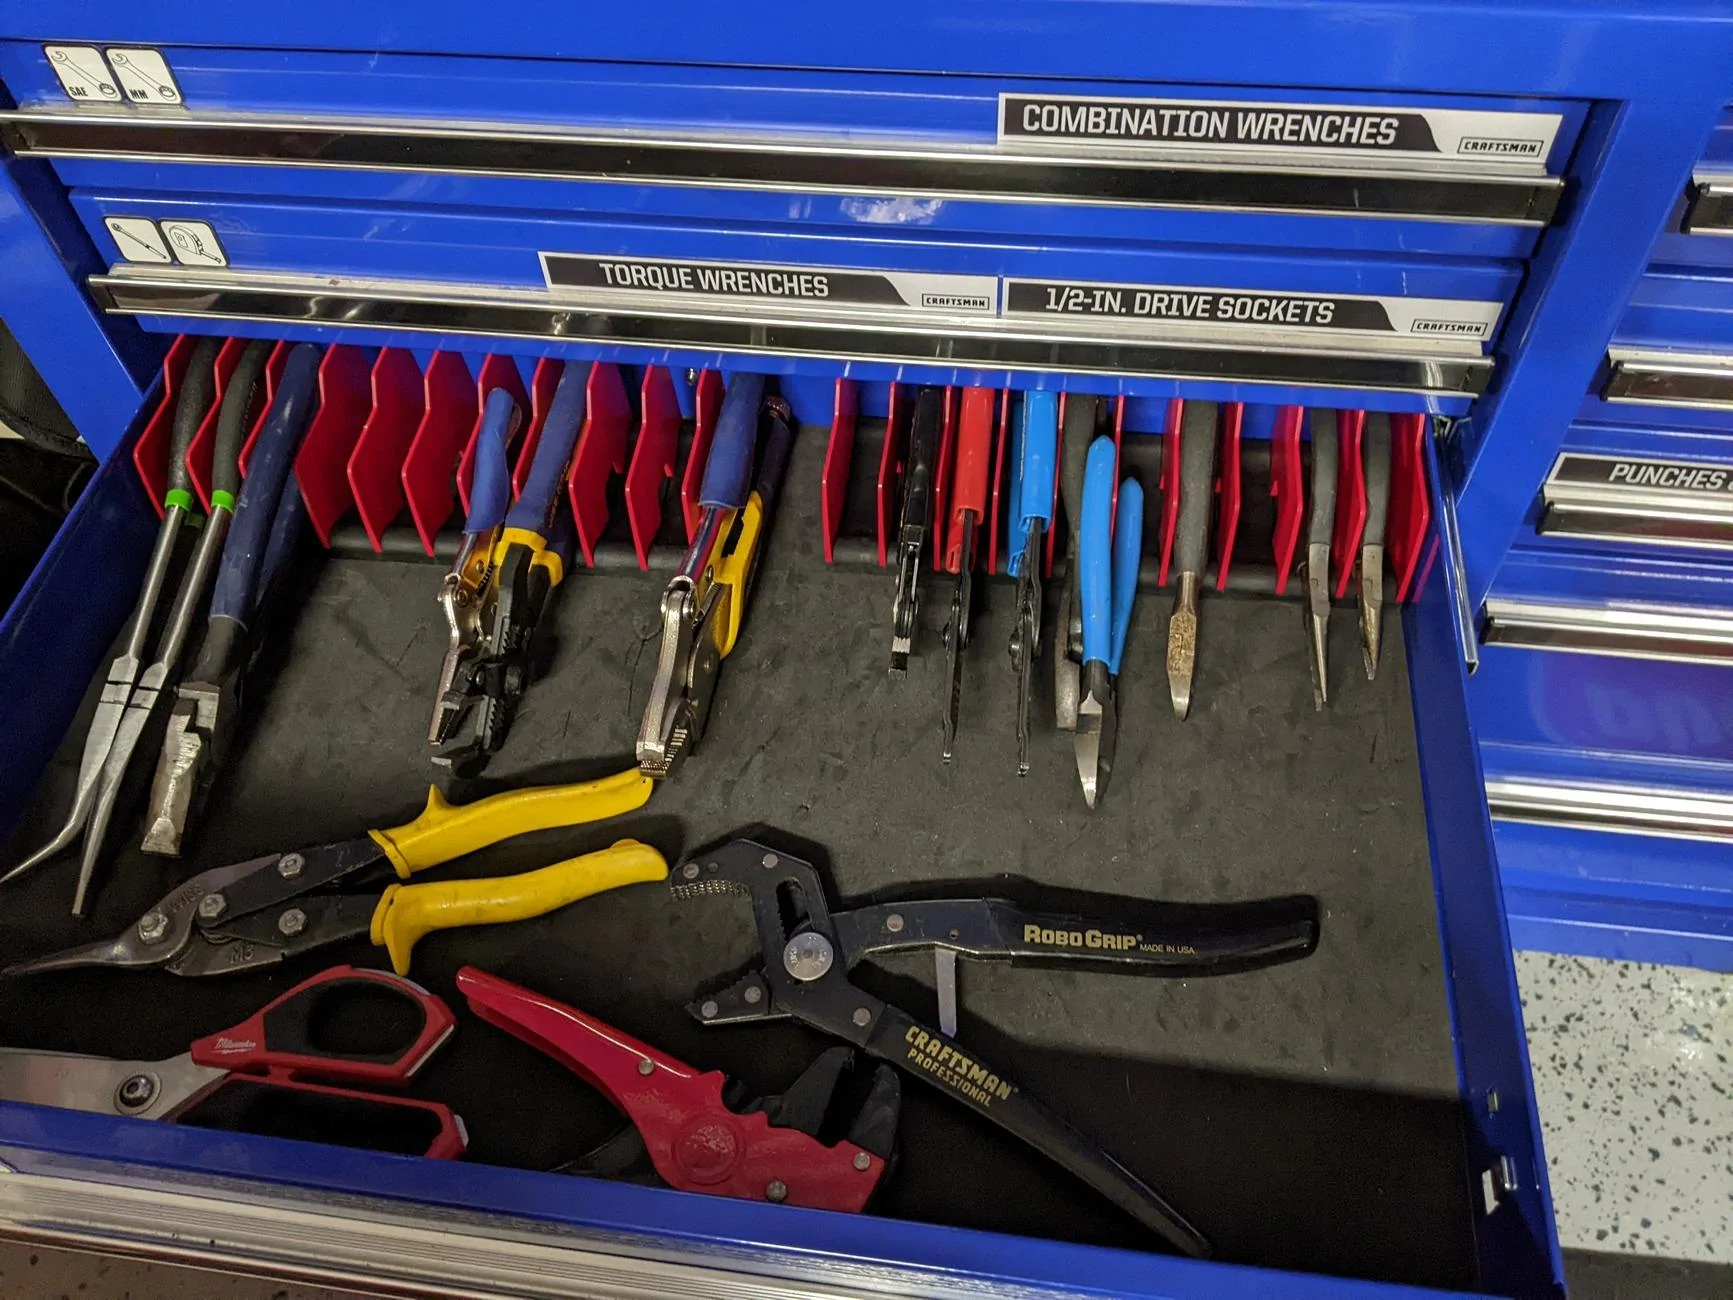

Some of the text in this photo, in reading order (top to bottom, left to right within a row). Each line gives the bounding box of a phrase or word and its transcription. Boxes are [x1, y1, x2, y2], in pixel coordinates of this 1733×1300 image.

[68, 86, 88, 97] SAE
[129, 89, 149, 99] MM
[1022, 104, 1399, 145] COMBINATION WRENCHES
[1463, 140, 1538, 153] CRAFTSMAN
[599, 262, 829, 298] TORQUE WRENCHES
[925, 296, 987, 308] CRAFTSMAN
[1045, 287, 1335, 324] 1/2-IN. DRIVE SOCKETS
[1416, 322, 1482, 333] CRAFTSMAN
[1607, 463, 1728, 490] PUNCHES
[1139, 943, 1196, 954] MADE IN USA
[907, 1048, 991, 1108] PROFESSIONAL
